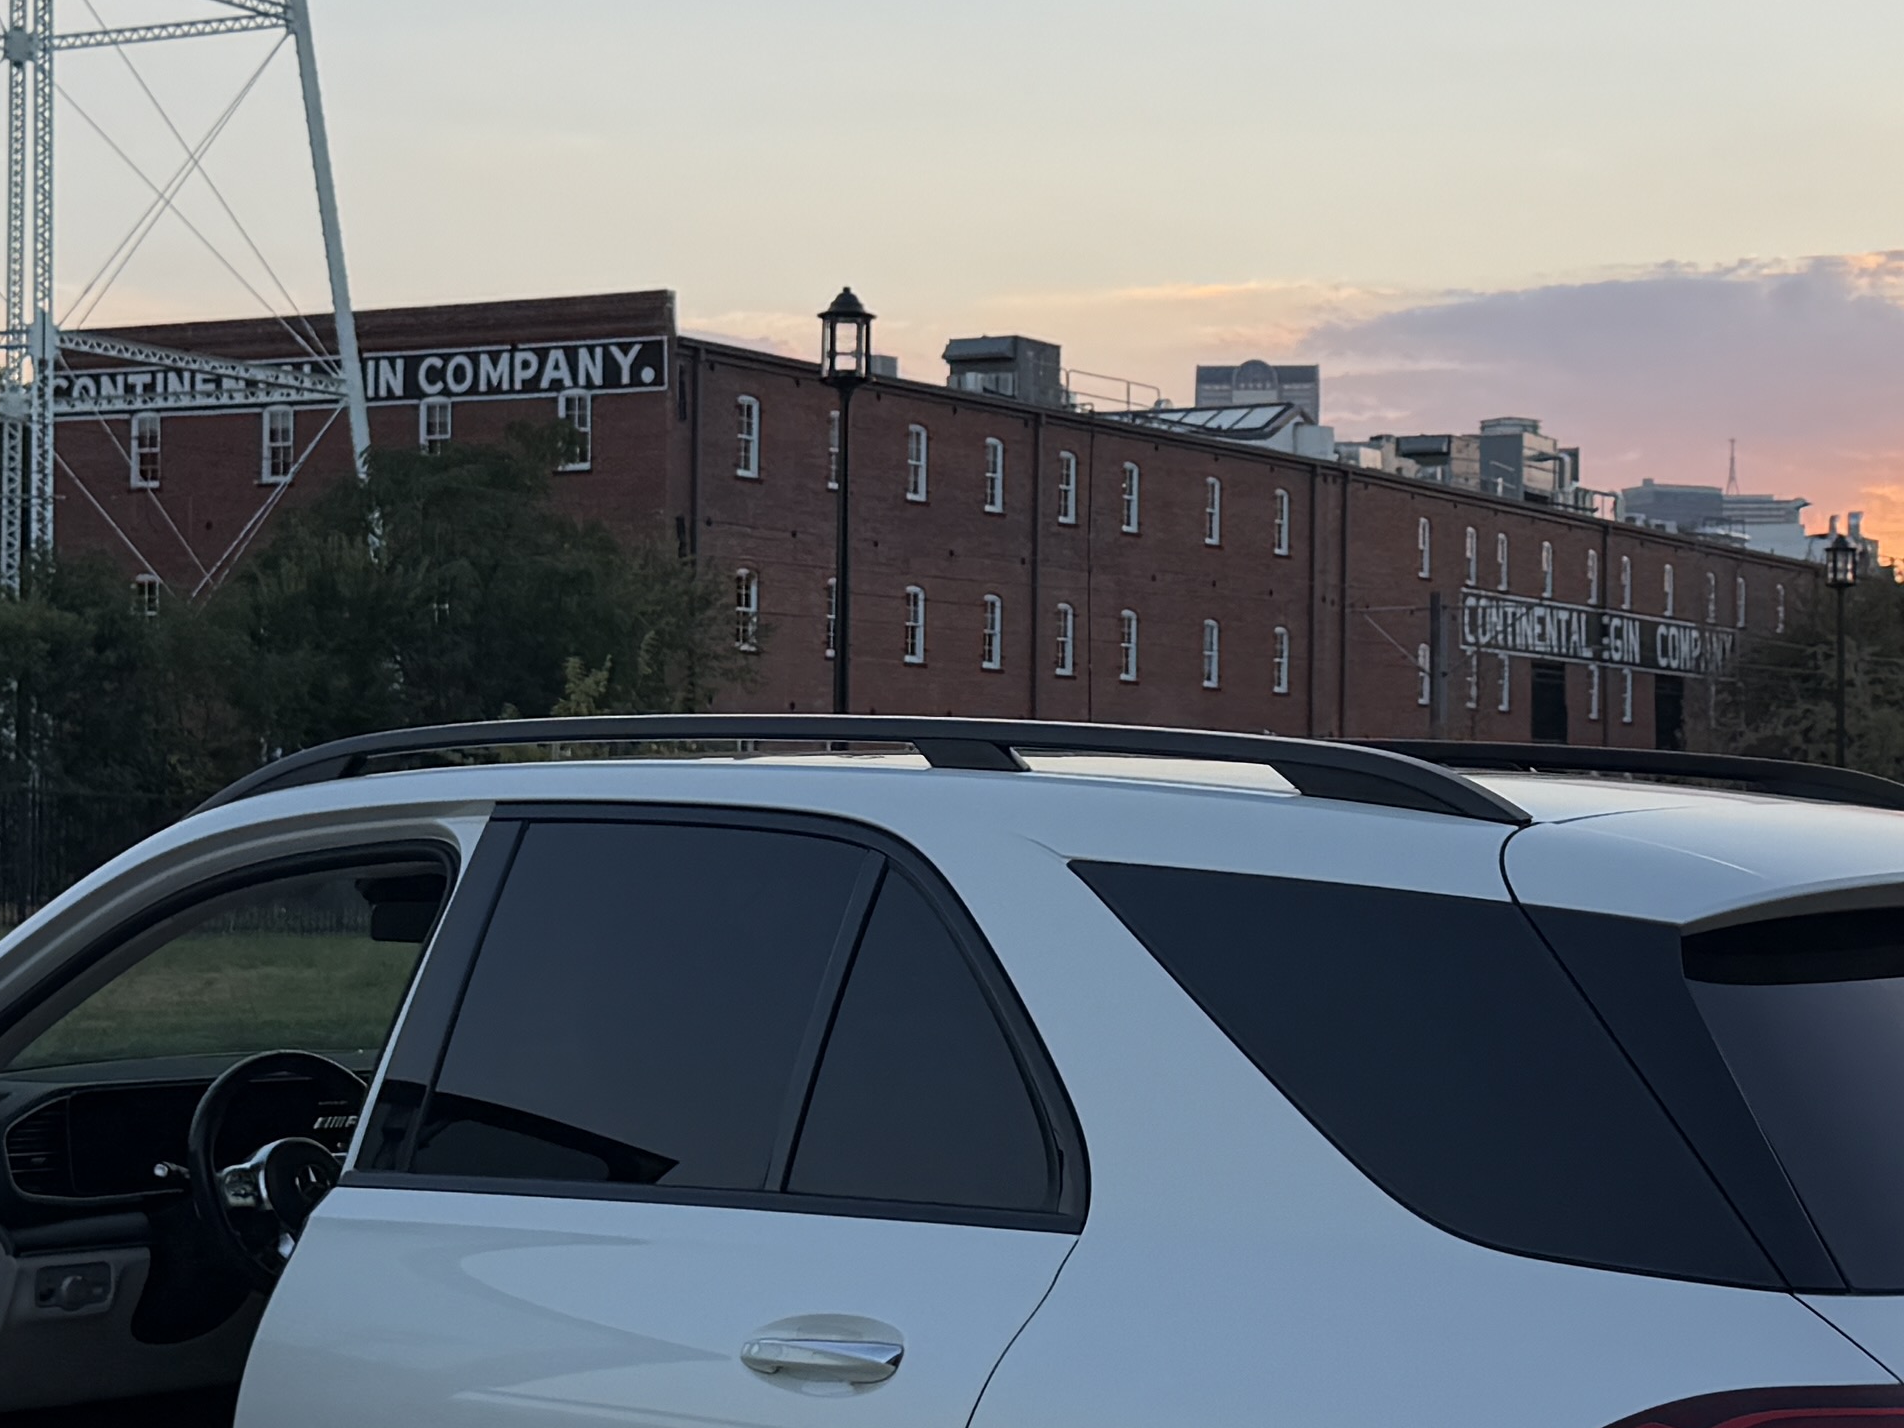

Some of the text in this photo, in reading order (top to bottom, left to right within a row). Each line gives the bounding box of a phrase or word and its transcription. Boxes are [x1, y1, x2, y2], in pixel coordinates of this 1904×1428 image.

[365, 357, 405, 399] IN
[1463, 595, 1595, 659] CONTINENTAL
[1609, 616, 1642, 665] GIN
